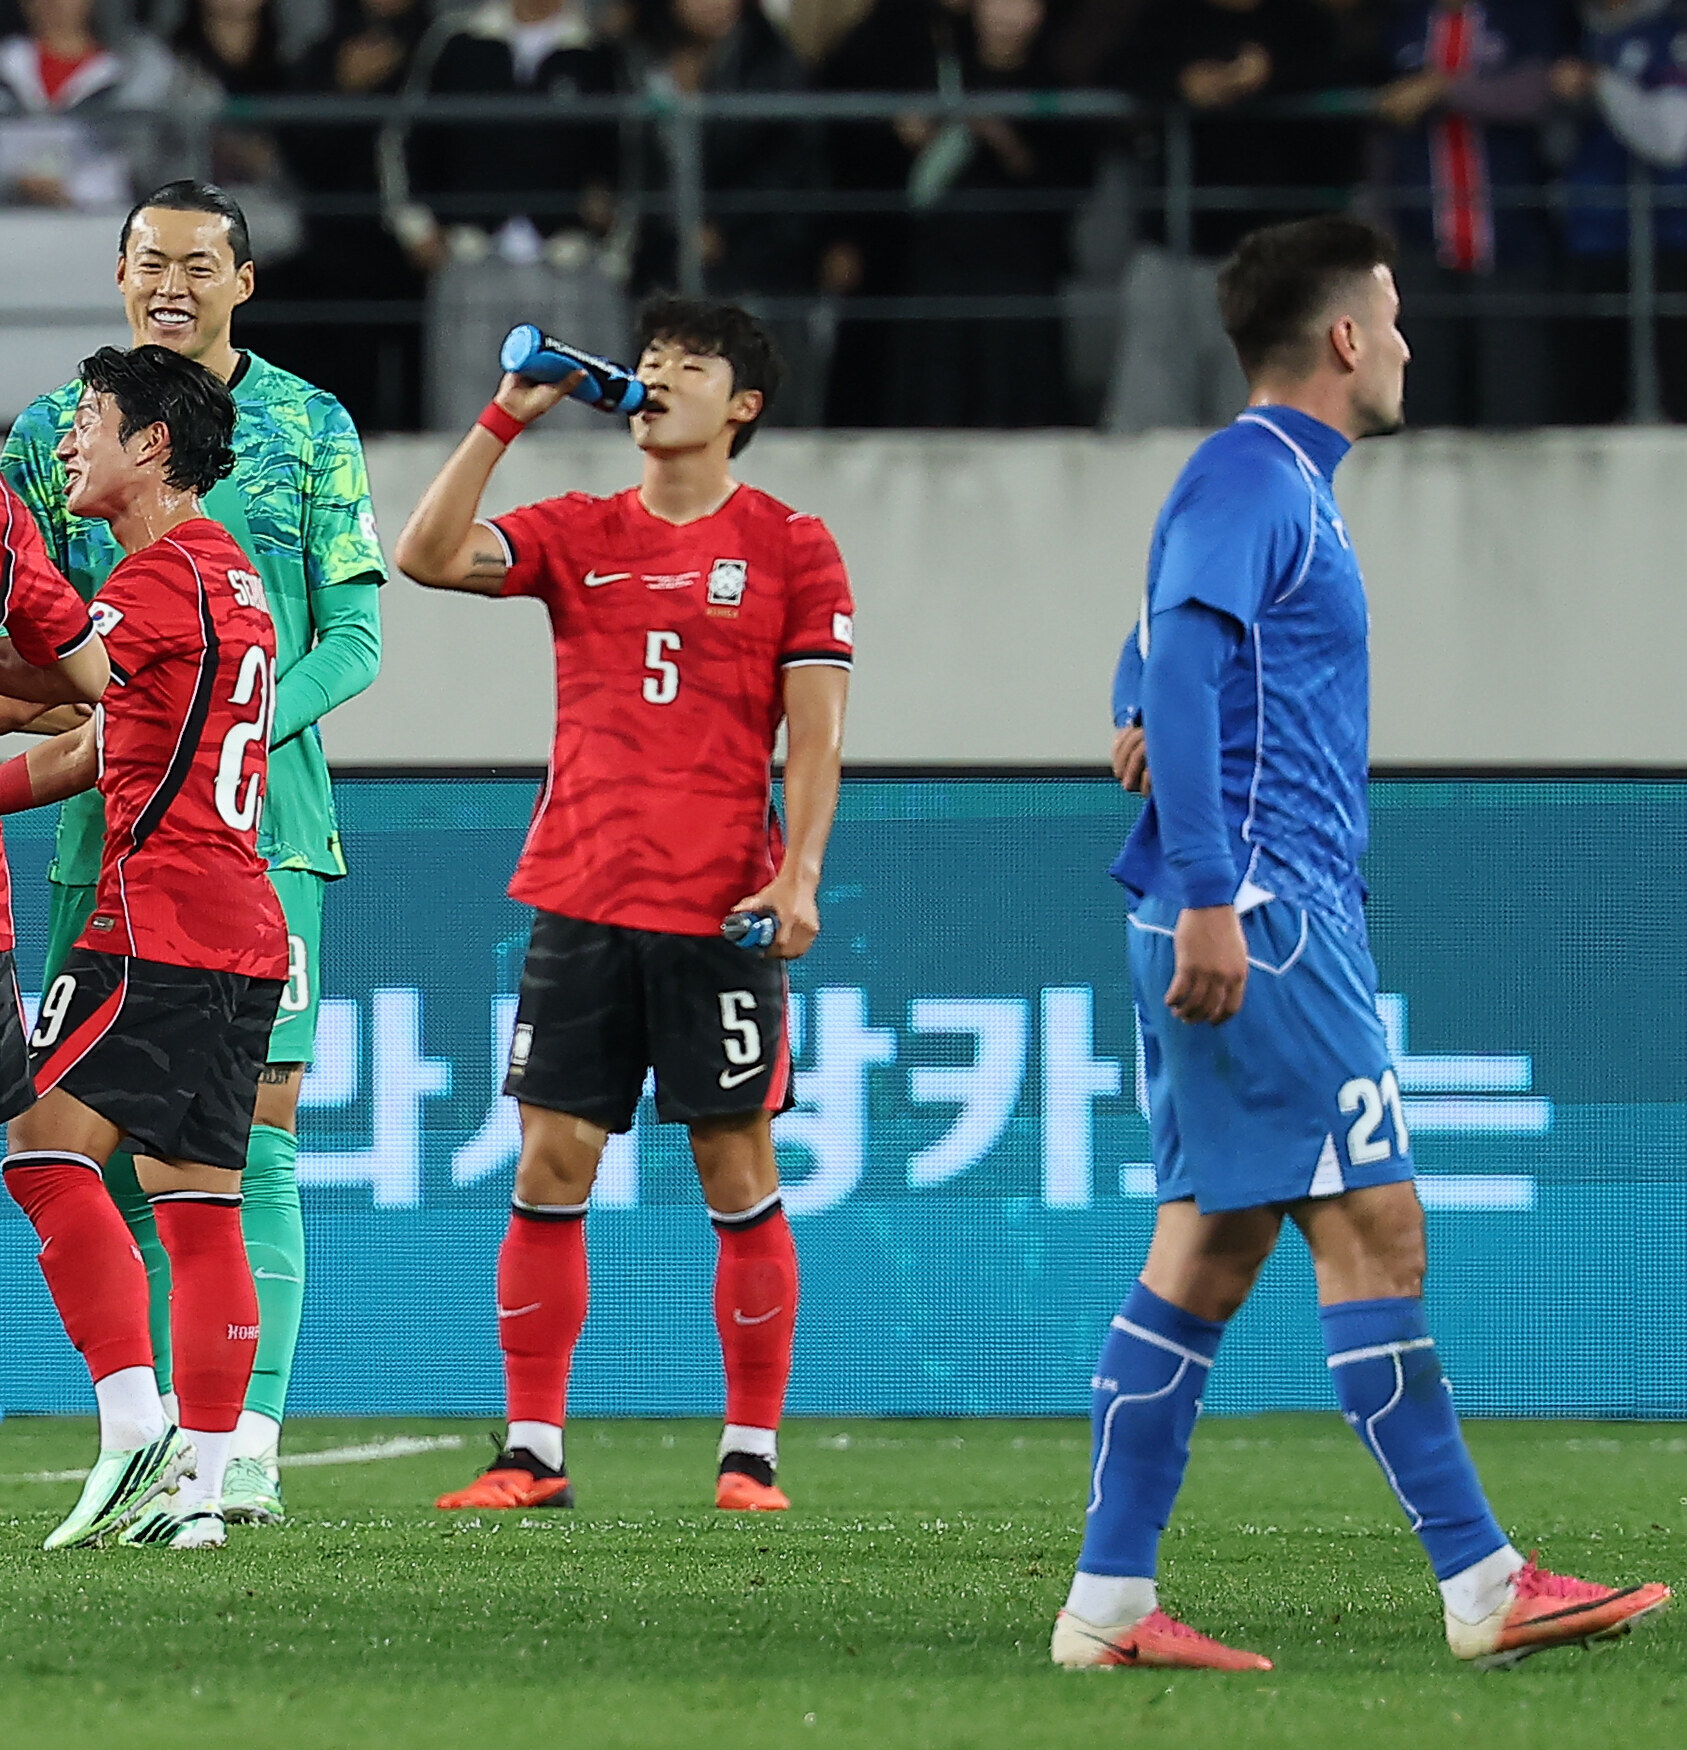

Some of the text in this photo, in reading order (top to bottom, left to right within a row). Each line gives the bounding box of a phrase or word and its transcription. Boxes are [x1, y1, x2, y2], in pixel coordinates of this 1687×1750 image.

[642, 630, 682, 704] 5
[717, 988, 766, 1066] 5
[1336, 1069, 1411, 1167] 21
